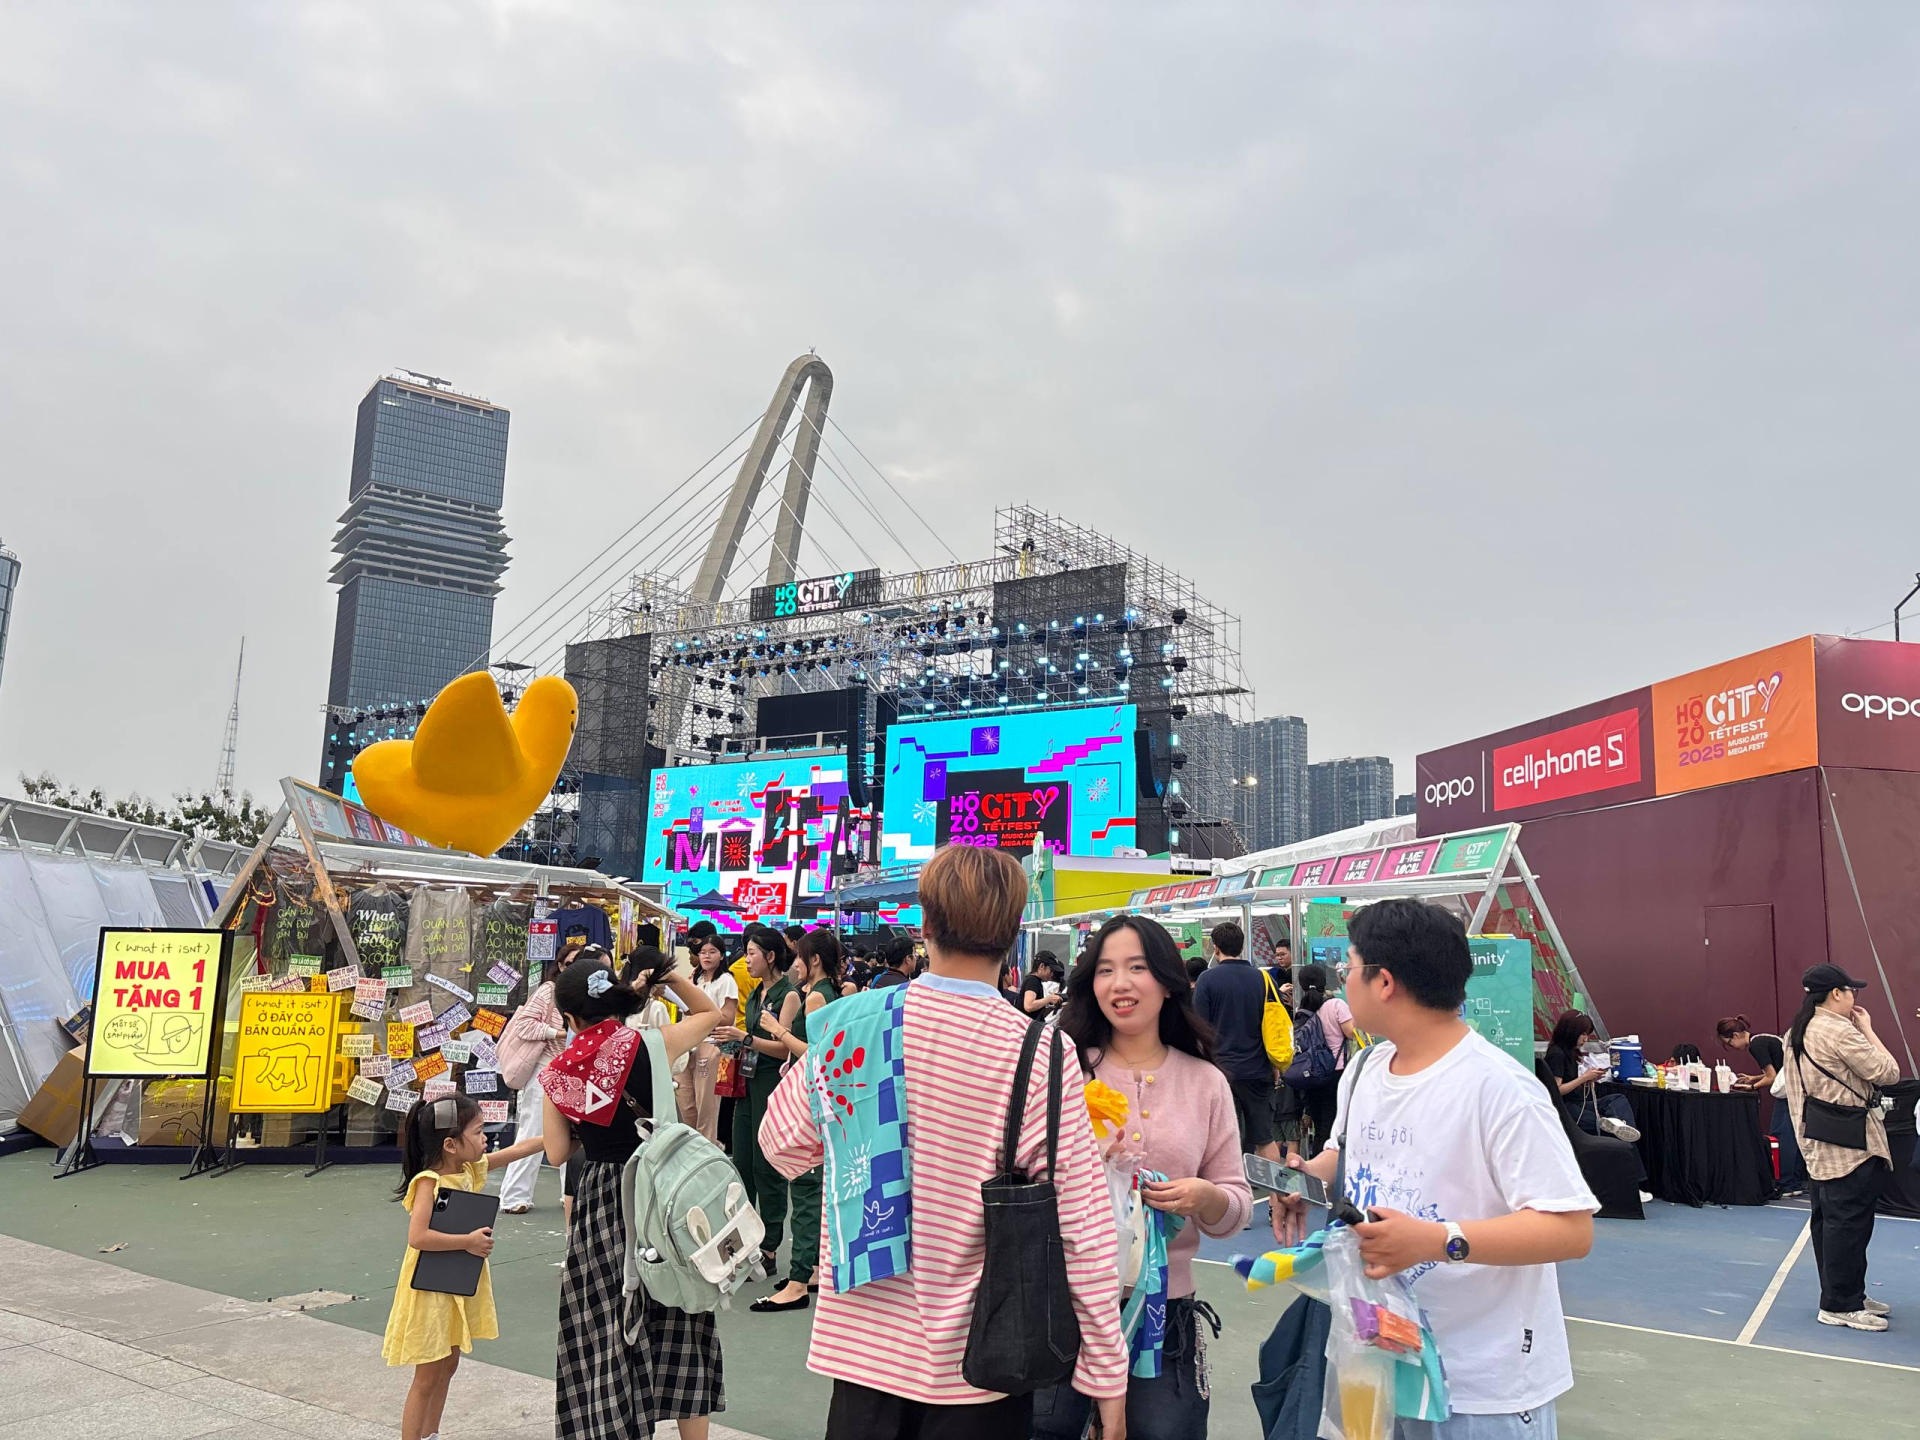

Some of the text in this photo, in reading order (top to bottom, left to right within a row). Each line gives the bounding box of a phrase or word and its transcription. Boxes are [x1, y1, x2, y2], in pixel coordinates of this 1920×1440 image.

[1728, 732, 1768, 747] MUSIC ARTS
[1679, 743, 1725, 767] 2025
[1728, 742, 1765, 756] MEGA FEST
[1425, 776, 1474, 807] oppo
[950, 834, 997, 847] 2025
[356, 910, 395, 920] What
[544, 924, 551, 932] 4
[115, 959, 205, 983] MUA 1
[114, 984, 202, 1012] TẶNG 1
[258, 1010, 267, 1022] Ở
[1361, 1120, 1412, 1146] YÊU ĐỜI
